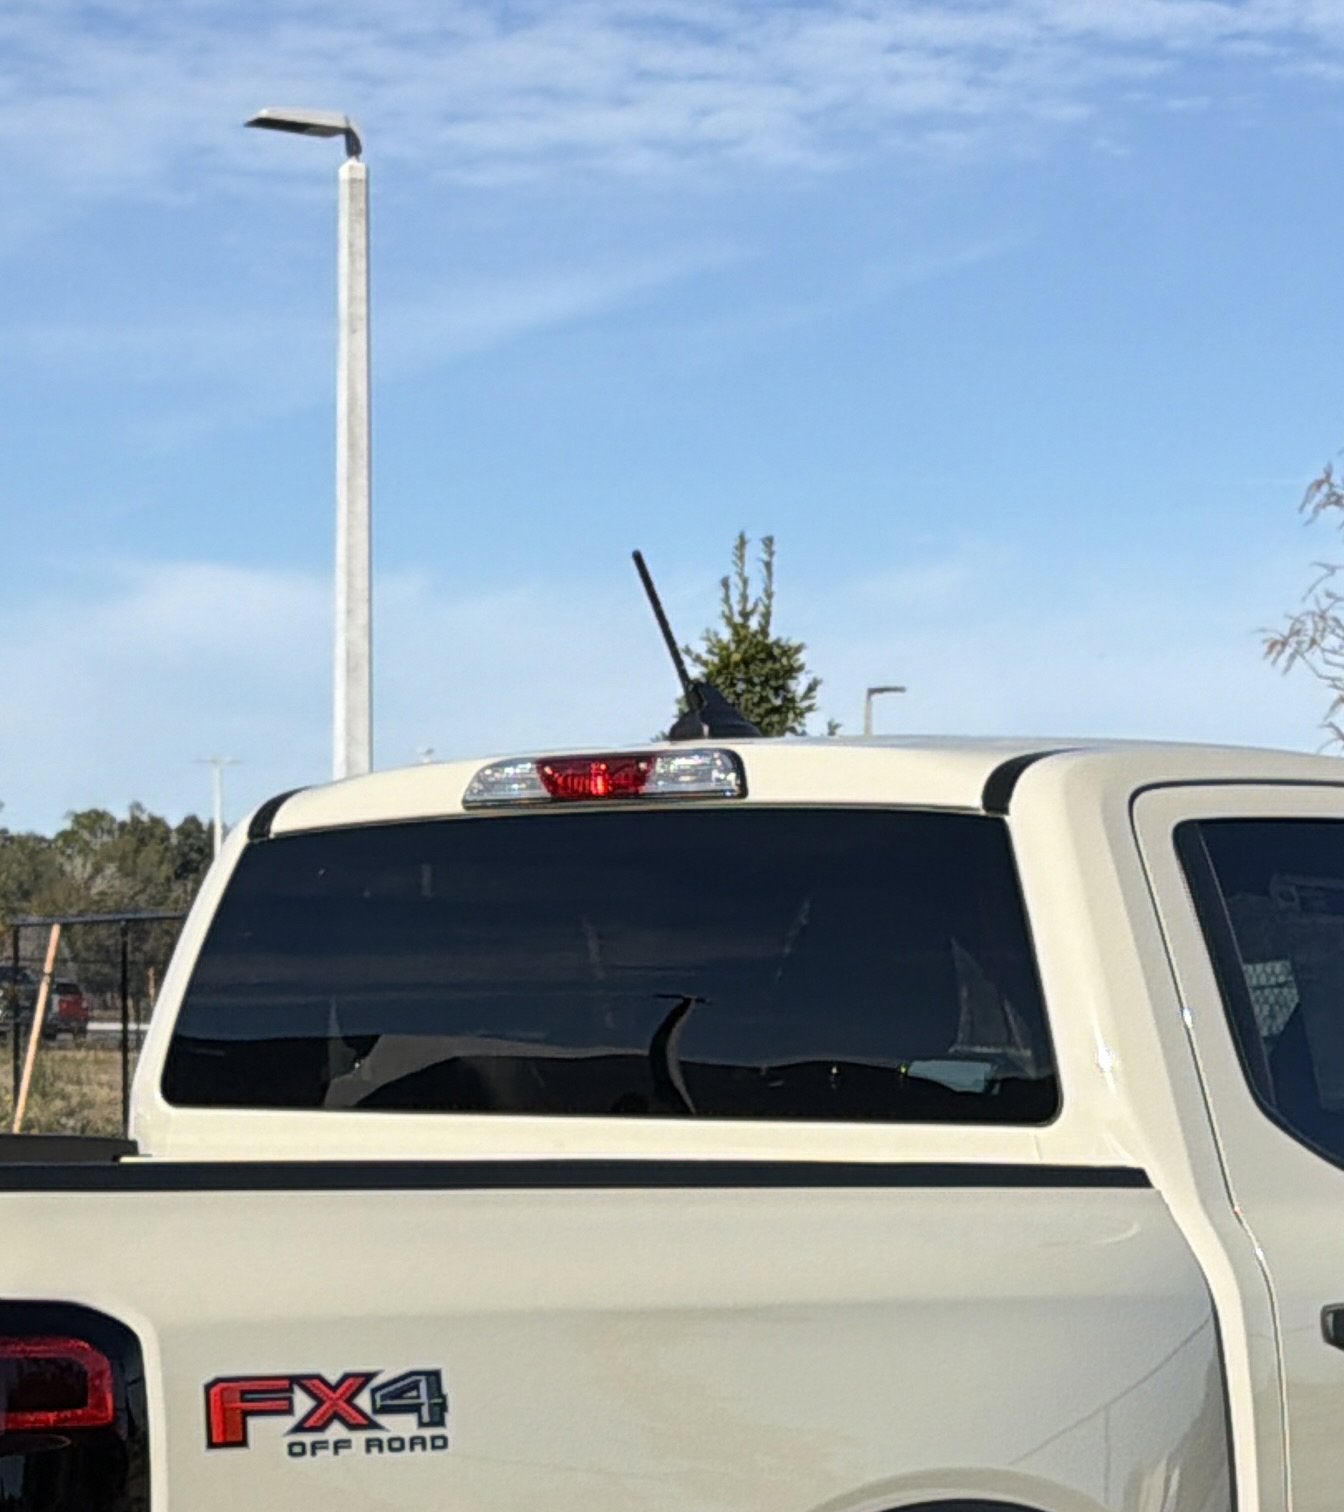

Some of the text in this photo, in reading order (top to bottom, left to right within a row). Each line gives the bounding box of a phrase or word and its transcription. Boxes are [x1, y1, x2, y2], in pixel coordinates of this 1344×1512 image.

[204, 1368, 449, 1450] FX4
[287, 1434, 449, 1458] OFF ROAD
